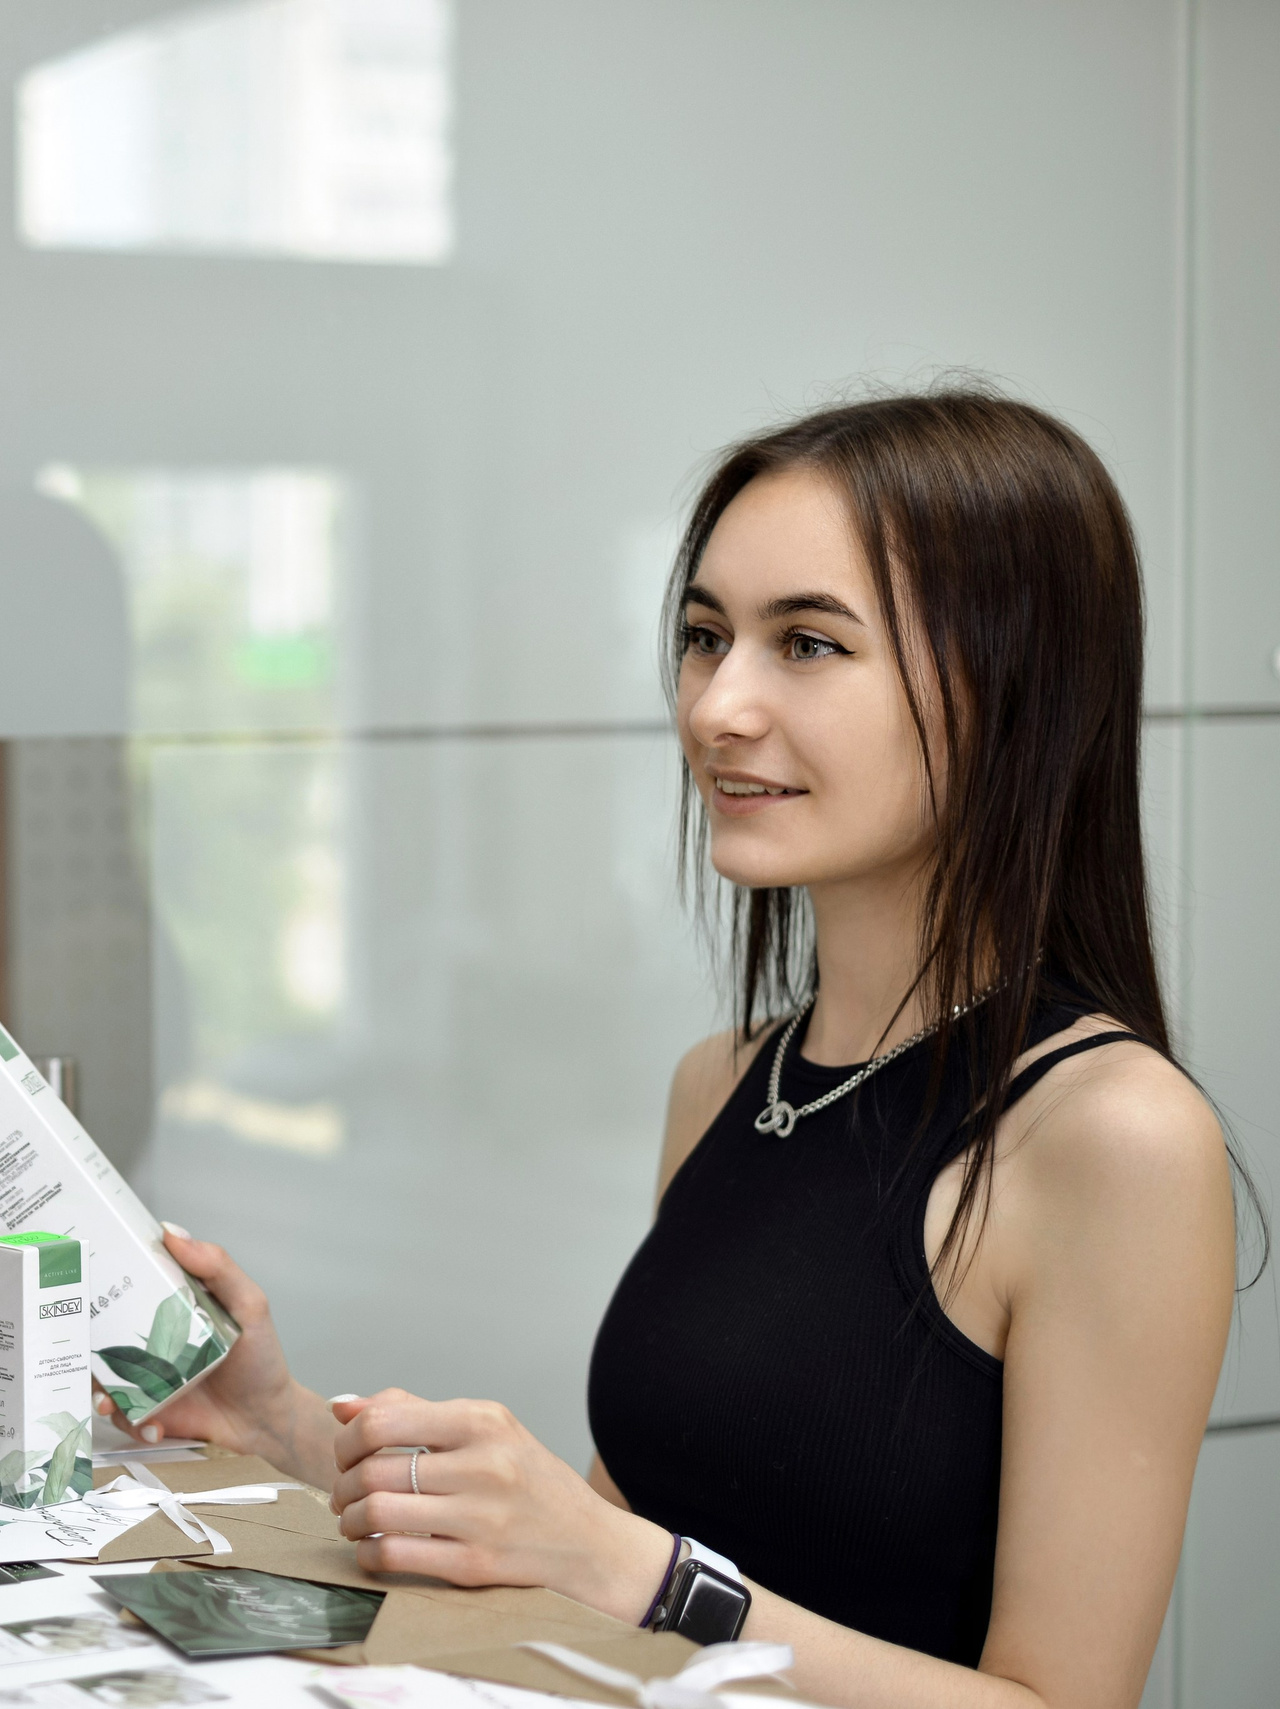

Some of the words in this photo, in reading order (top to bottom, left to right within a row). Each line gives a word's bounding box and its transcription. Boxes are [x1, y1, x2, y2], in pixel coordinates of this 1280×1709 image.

[43, 1270, 63, 1278] ACTIVE
[41, 1300, 80, 1318] SKINDEX
[39, 1353, 83, 1366] ДЕТОКС-СЫВОРОТКА
[34, 1365, 88, 1379] УЛЬТРАВОССТАНОВЛЕНИЕ
